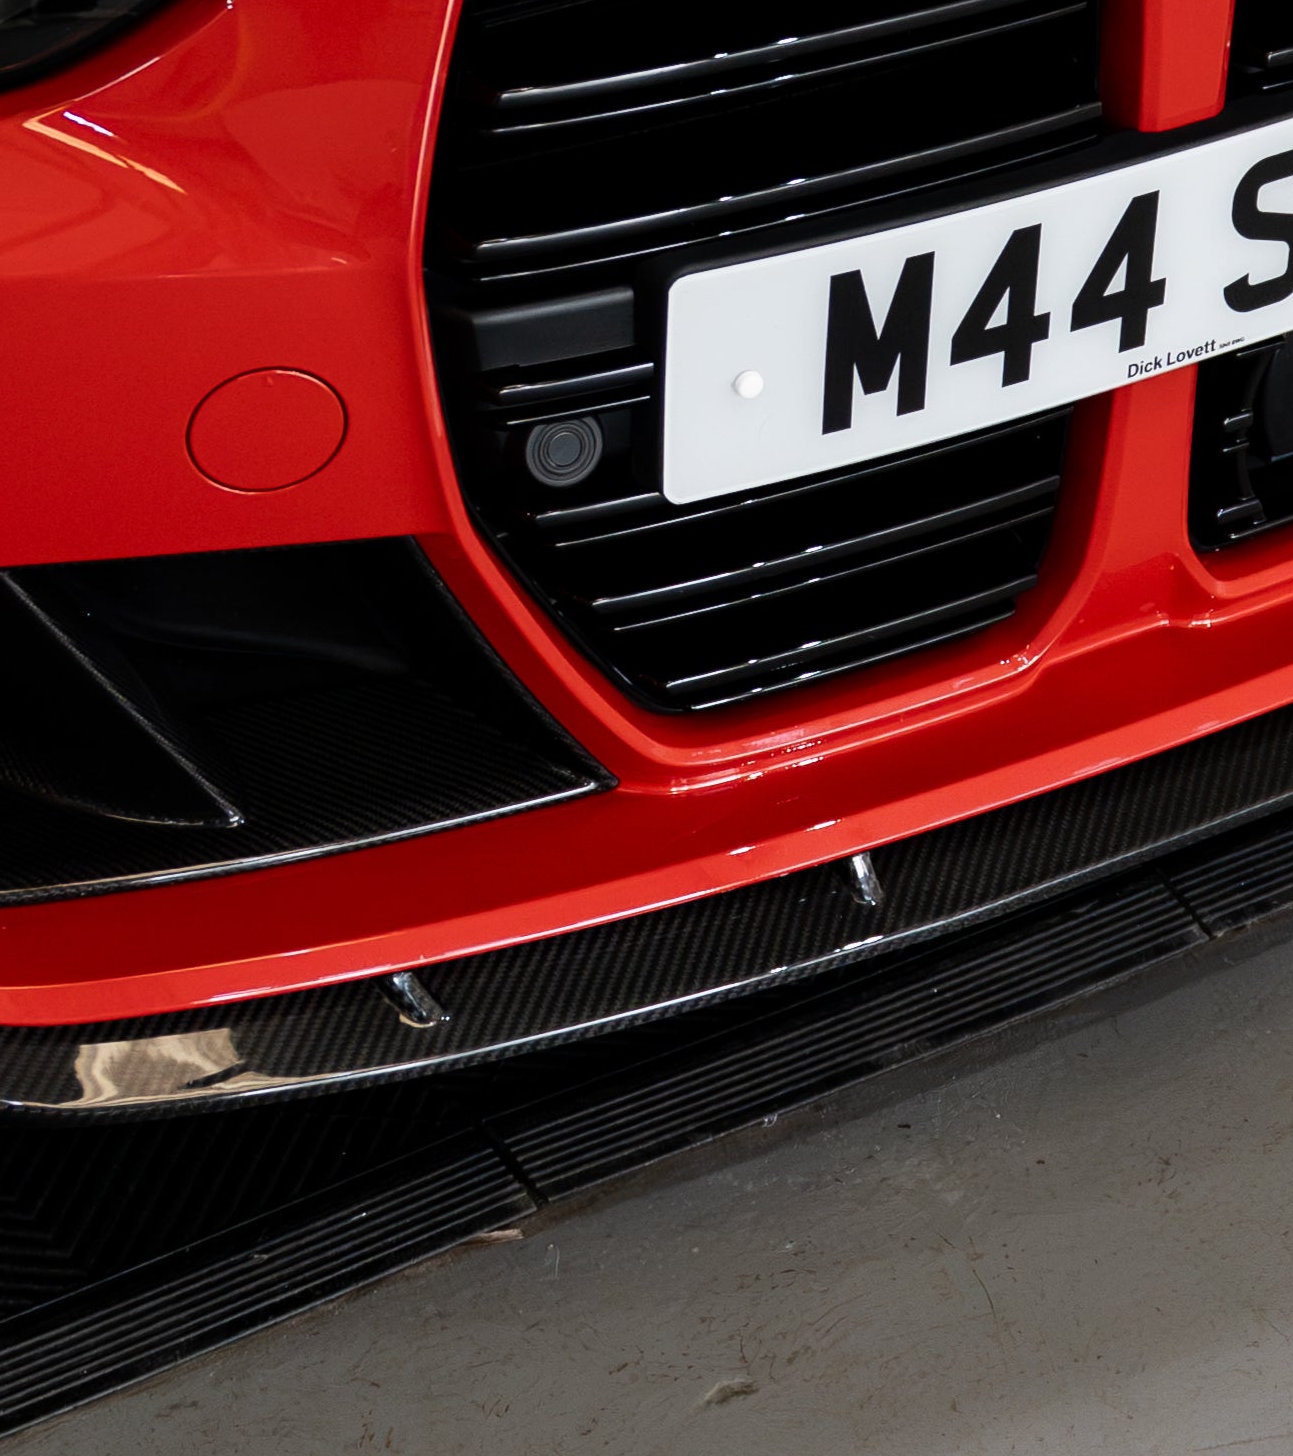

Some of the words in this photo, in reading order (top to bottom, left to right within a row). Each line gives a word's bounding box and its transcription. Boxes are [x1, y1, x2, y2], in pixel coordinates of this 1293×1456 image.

[822, 190, 1167, 435] M44
[1127, 356, 1162, 378] Dick
[1166, 339, 1216, 366] Lovett
